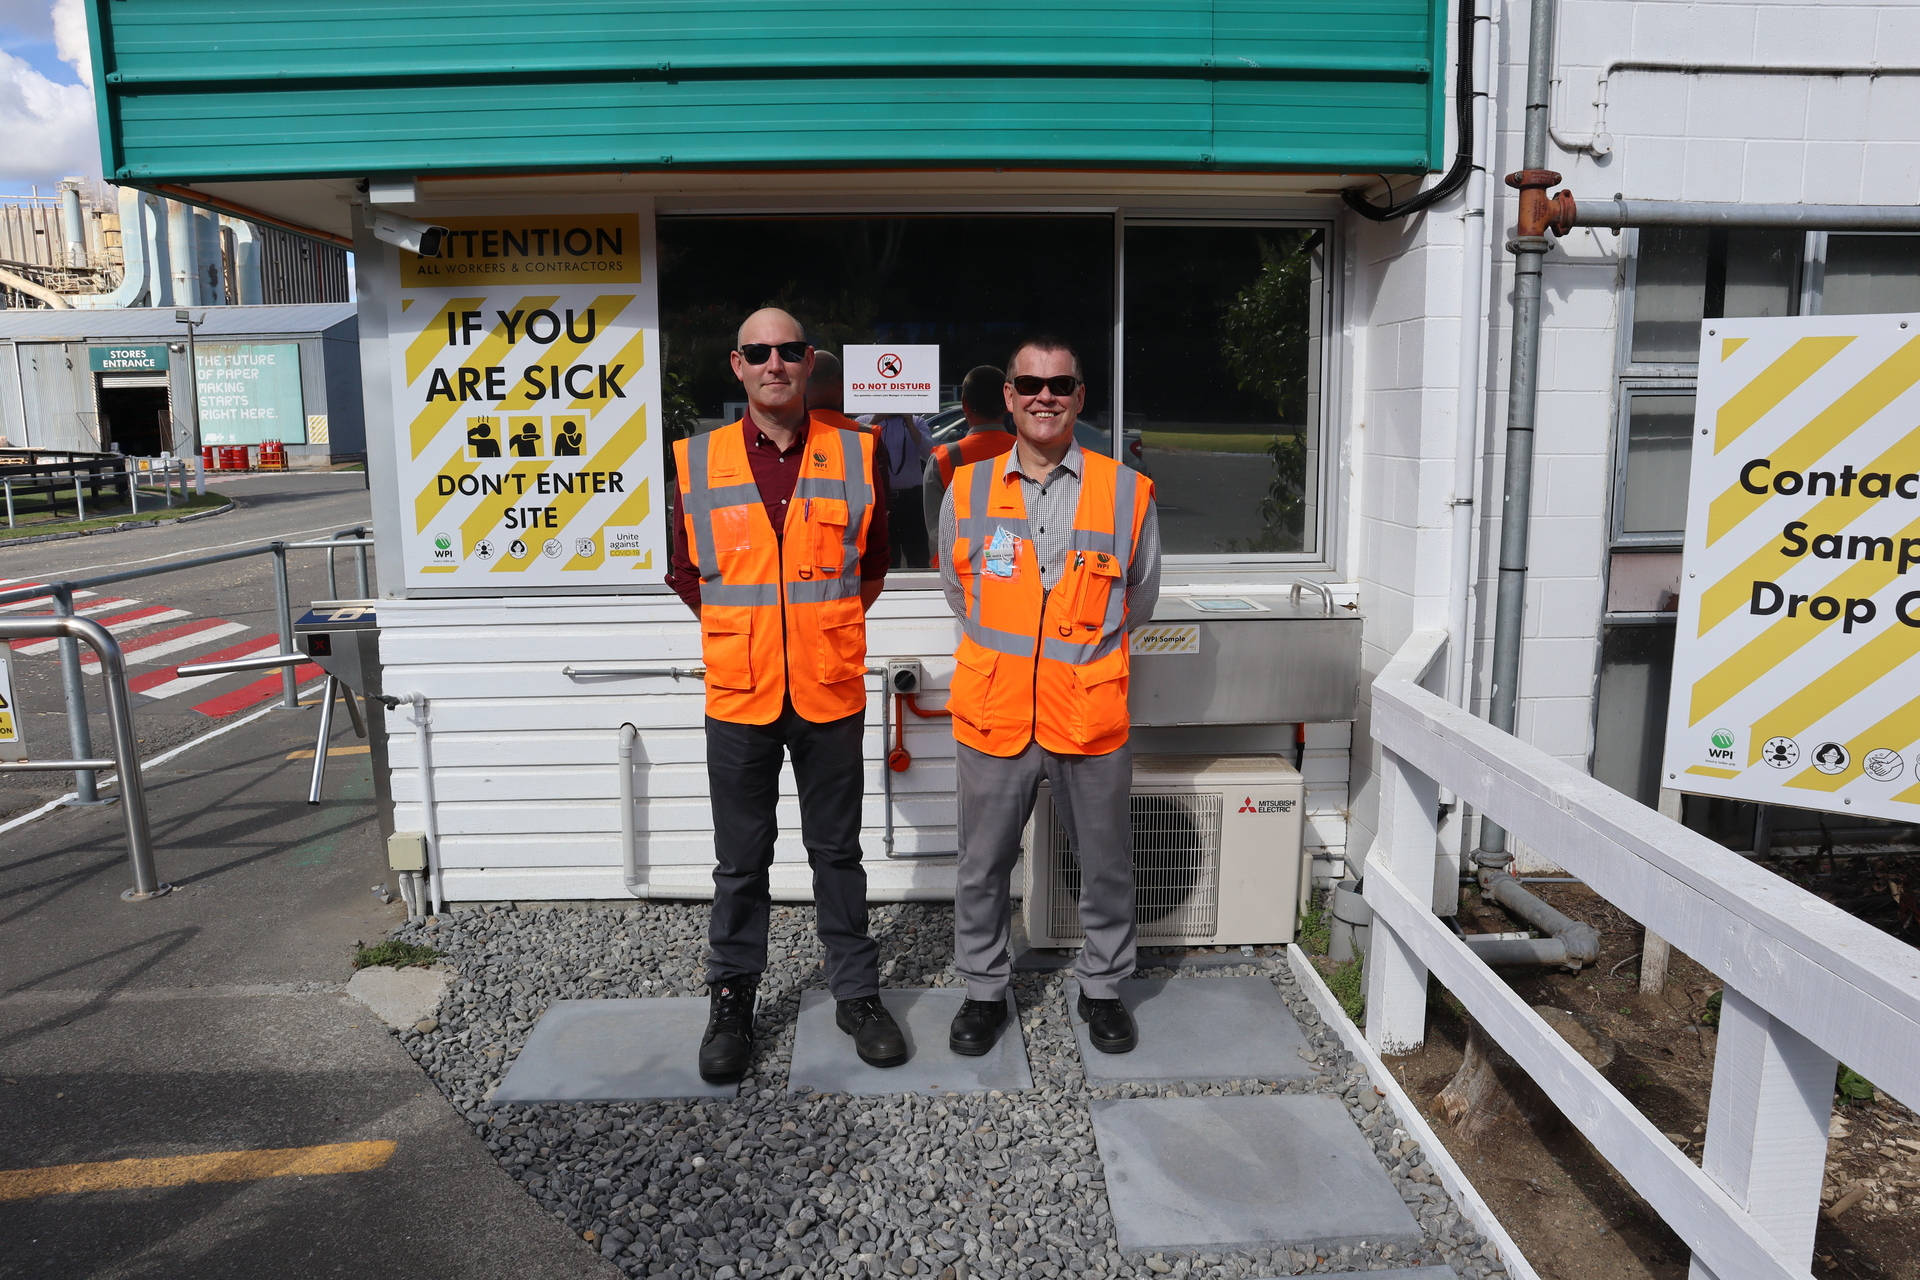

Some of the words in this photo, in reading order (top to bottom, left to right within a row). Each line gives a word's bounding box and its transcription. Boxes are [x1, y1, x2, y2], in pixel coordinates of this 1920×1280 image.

[417, 227, 622, 259] TTENTION
[418, 265, 440, 275] ALL
[445, 263, 506, 274] WORKERS
[511, 263, 519, 272] &
[525, 261, 623, 272] CONTRACTORS
[447, 311, 482, 346] IF
[496, 309, 596, 345] YOU
[110, 350, 147, 359] STORES
[196, 355, 222, 366] THE
[224, 354, 276, 366] FUTURE
[103, 359, 155, 368] ENTRANCE
[197, 369, 214, 380] OF
[217, 368, 259, 379] PAPER
[198, 382, 245, 393] MAKING
[425, 366, 506, 402] ARE
[524, 364, 627, 400] SICK
[200, 395, 249, 406] STARTS
[201, 408, 237, 420] RIGHT
[241, 408, 278, 419] HERE.
[437, 473, 526, 496] DON'T
[537, 471, 625, 494] ENTER
[1739, 458, 1920, 500] Contac
[504, 507, 558, 529] SITE
[616, 533, 639, 541] Unite
[610, 541, 639, 550] against
[434, 550, 453, 558] WPI
[1096, 562, 1110, 570] WPI
[1750, 580, 1877, 634] Drop
[1160, 635, 1186, 643] Sample
[1708, 748, 1733, 760] WPI
